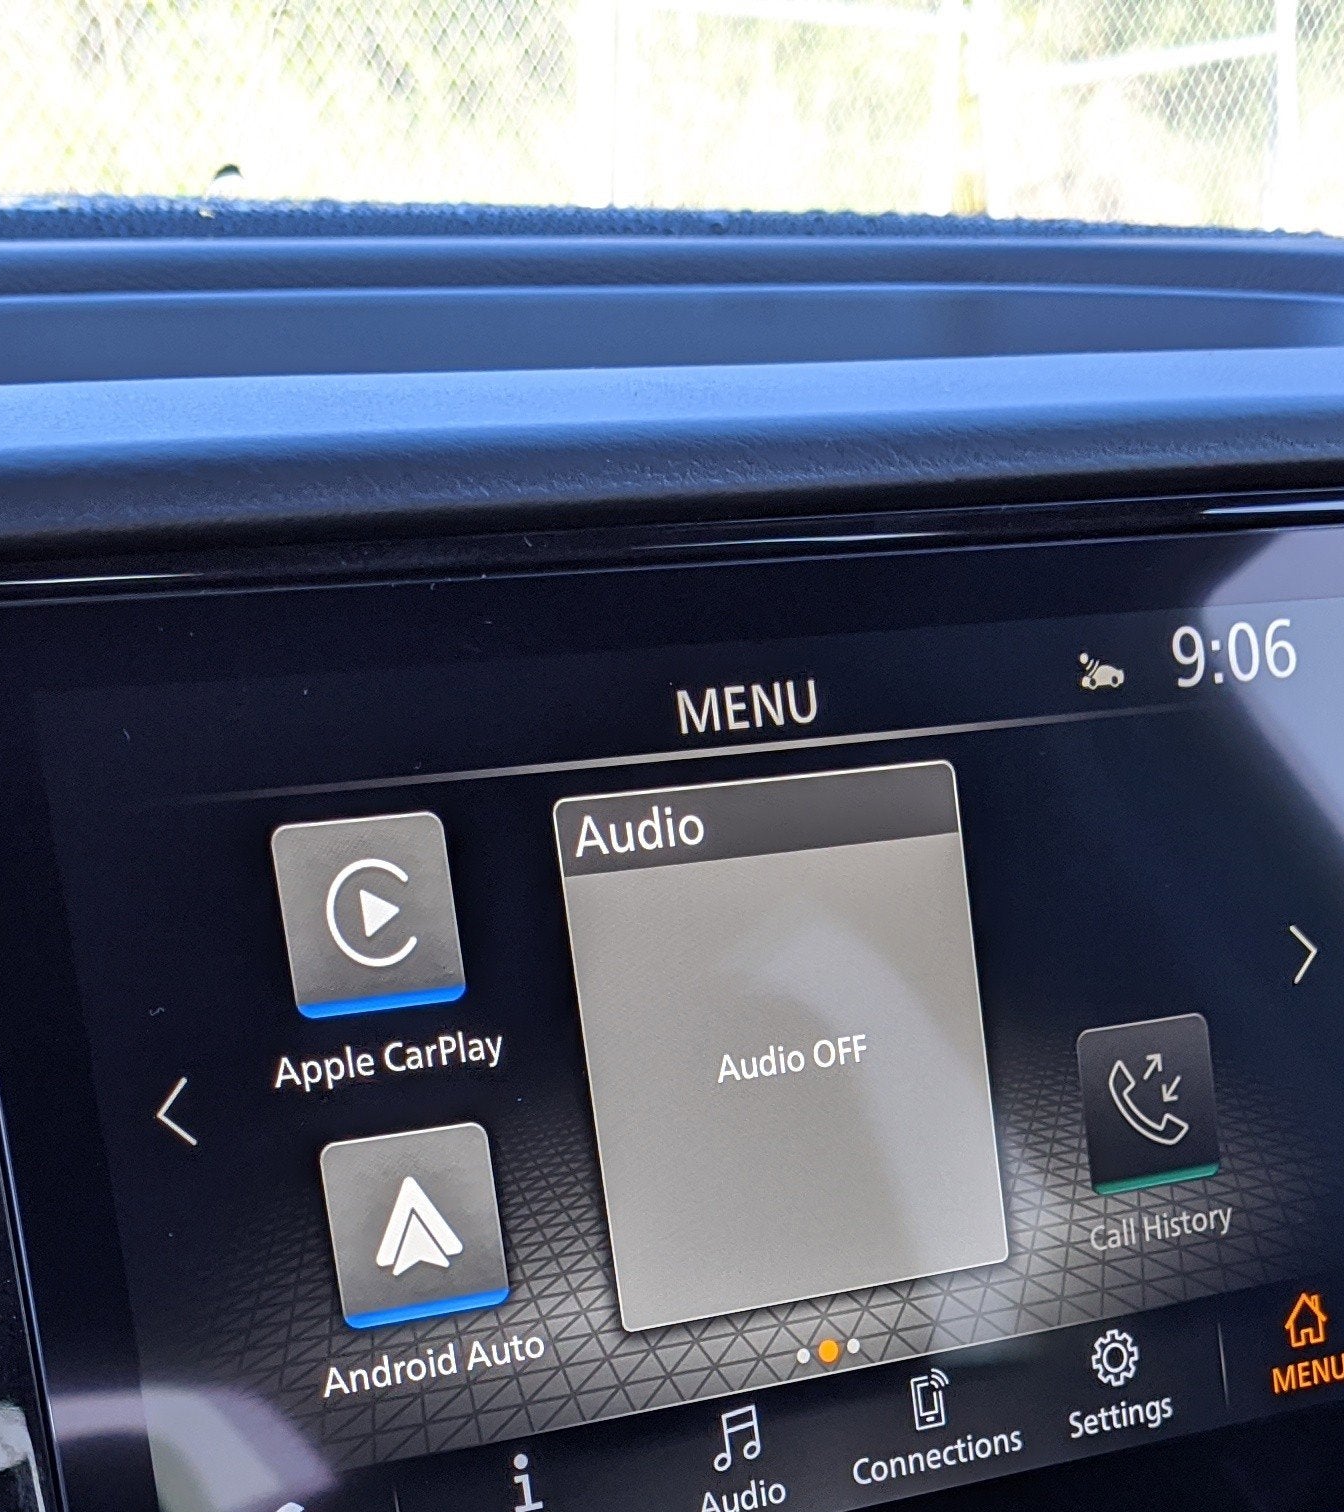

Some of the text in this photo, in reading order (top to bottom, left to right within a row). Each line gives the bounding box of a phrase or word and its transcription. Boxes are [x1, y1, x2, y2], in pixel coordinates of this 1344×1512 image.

[1171, 619, 1298, 688] 9:06
[676, 679, 818, 735] MENU
[574, 806, 705, 857] Audio
[274, 1033, 503, 1091] Apple CarPlay
[717, 1034, 867, 1083] Audio OFF
[1090, 1205, 1233, 1252] Call History
[323, 1336, 545, 1398] Android Auto
[1069, 1395, 1173, 1439] Settings
[853, 1427, 1023, 1486] Connections
